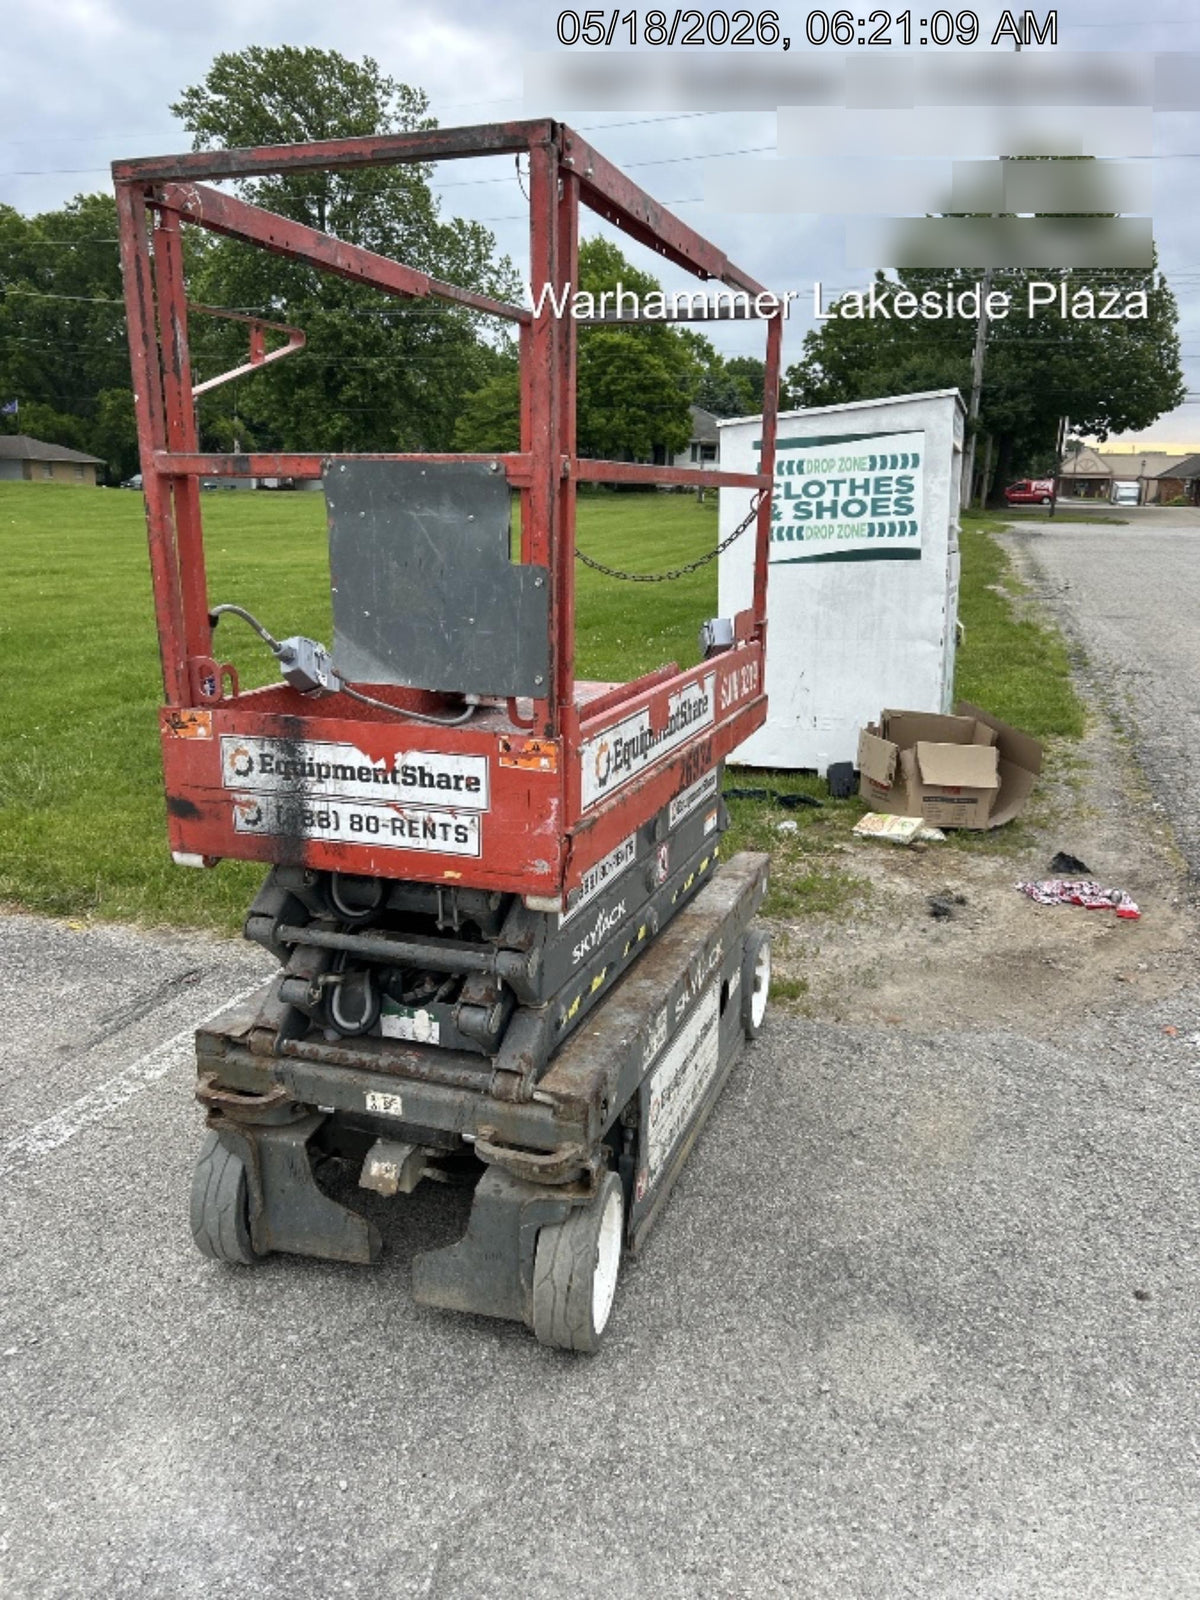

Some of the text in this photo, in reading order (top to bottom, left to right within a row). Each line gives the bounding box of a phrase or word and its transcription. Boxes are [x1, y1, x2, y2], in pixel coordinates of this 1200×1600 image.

[806, 455, 868, 475] DROP ZONE
[793, 497, 915, 520] SHOES
[805, 522, 867, 541] DROP ZONE
[276, 804, 469, 844] (88) 80-RENTS
[572, 898, 627, 965] SKYJACK
